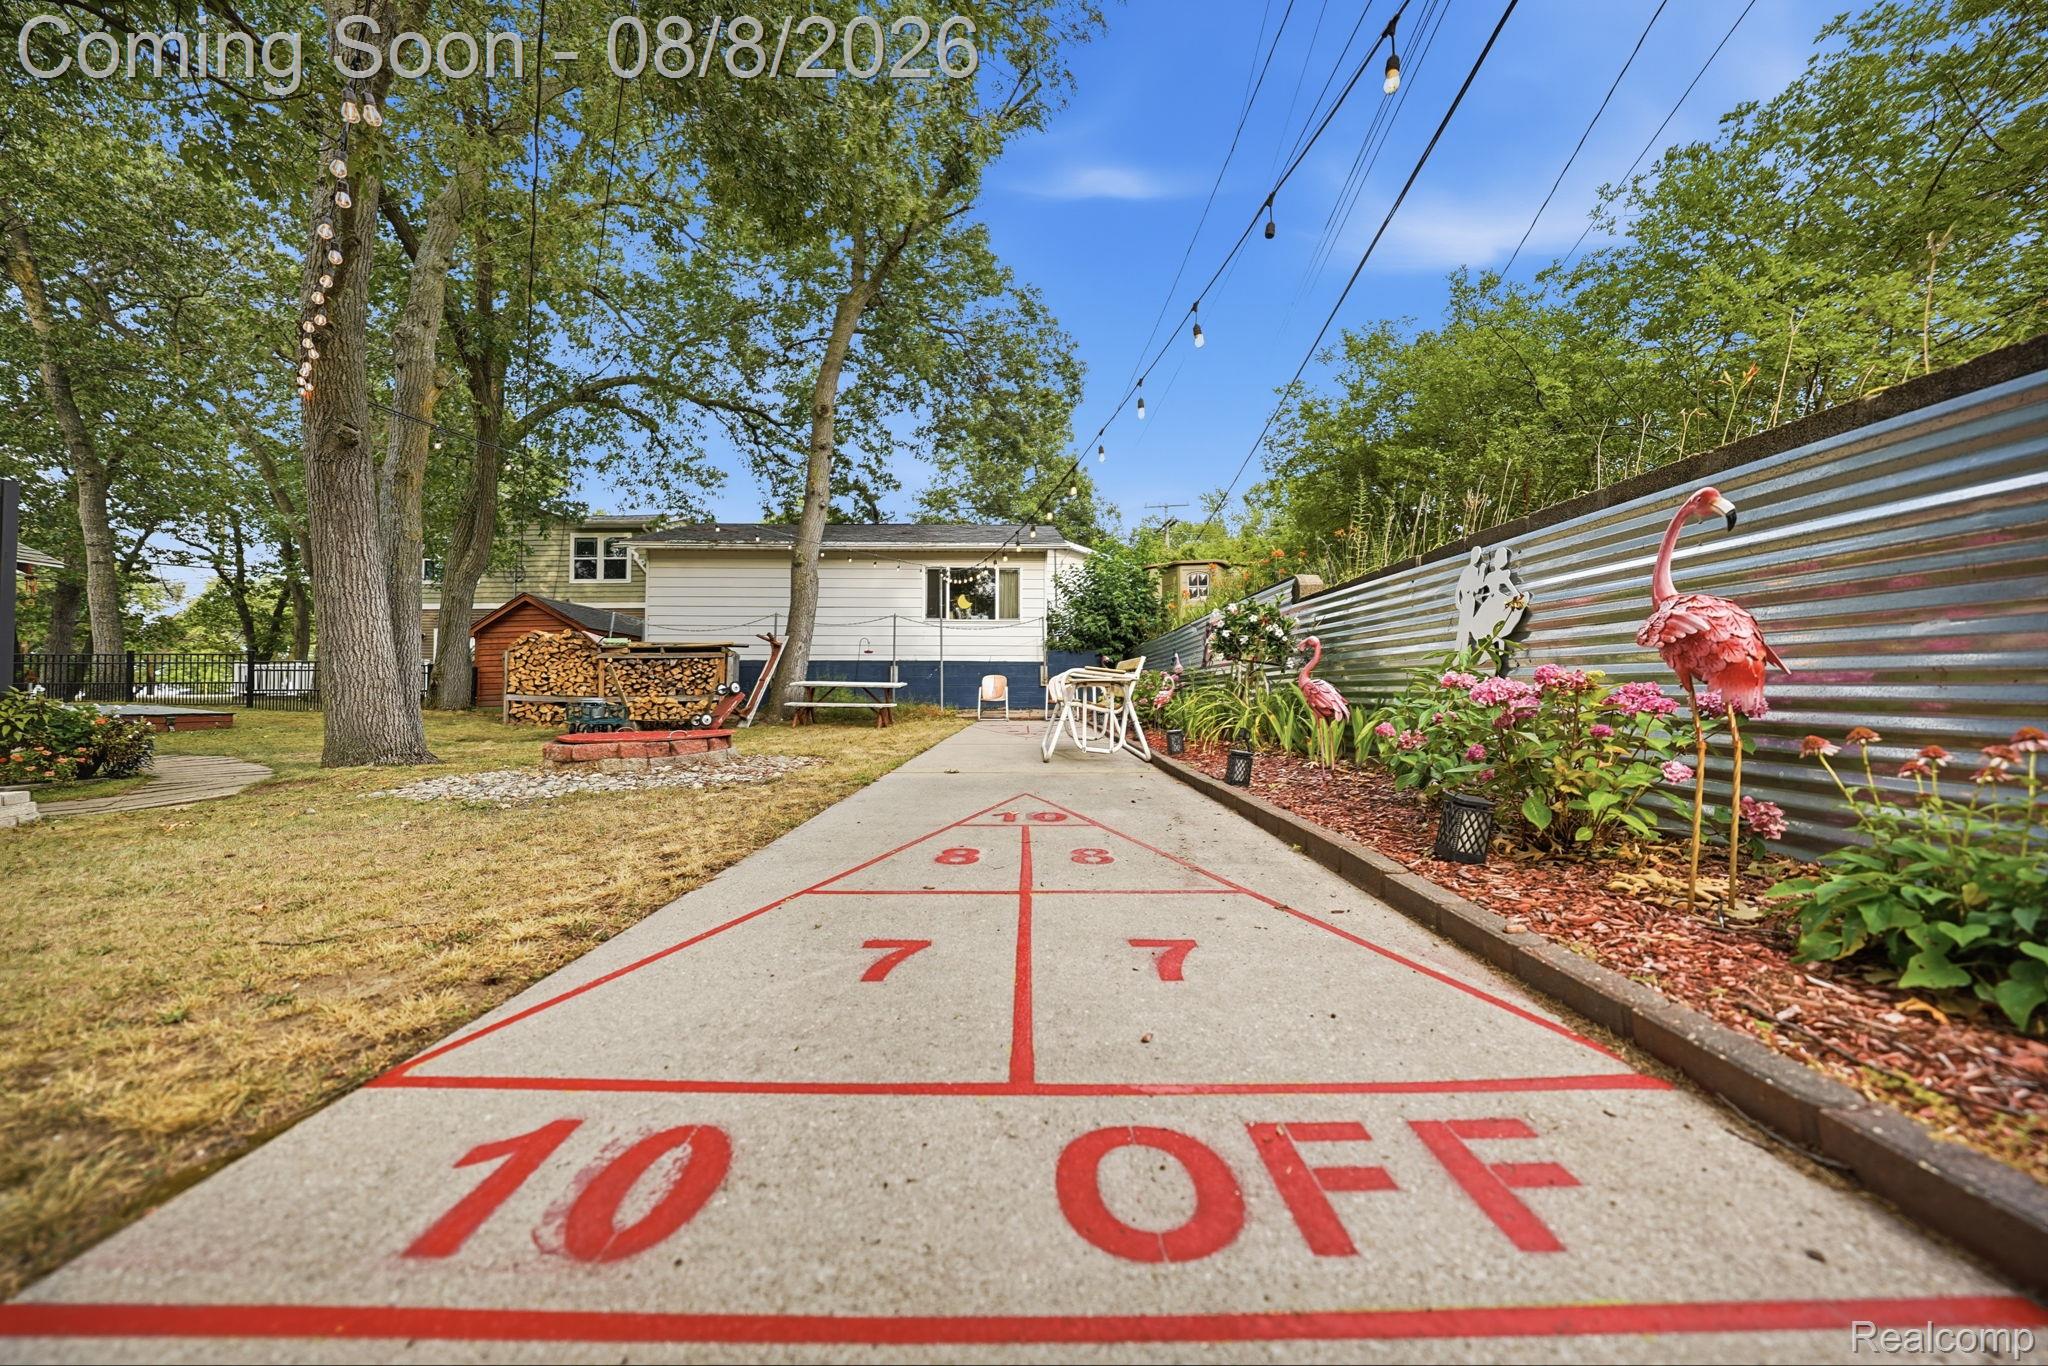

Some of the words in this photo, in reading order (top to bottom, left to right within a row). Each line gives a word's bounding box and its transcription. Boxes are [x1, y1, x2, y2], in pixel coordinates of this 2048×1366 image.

[992, 811, 1069, 823] 10
[935, 847, 981, 865] 8
[1071, 847, 1115, 865] 8
[860, 938, 932, 983] 7
[1128, 938, 1198, 982] 7
[401, 1118, 734, 1265] 10
[1056, 1117, 1581, 1265] OFF
